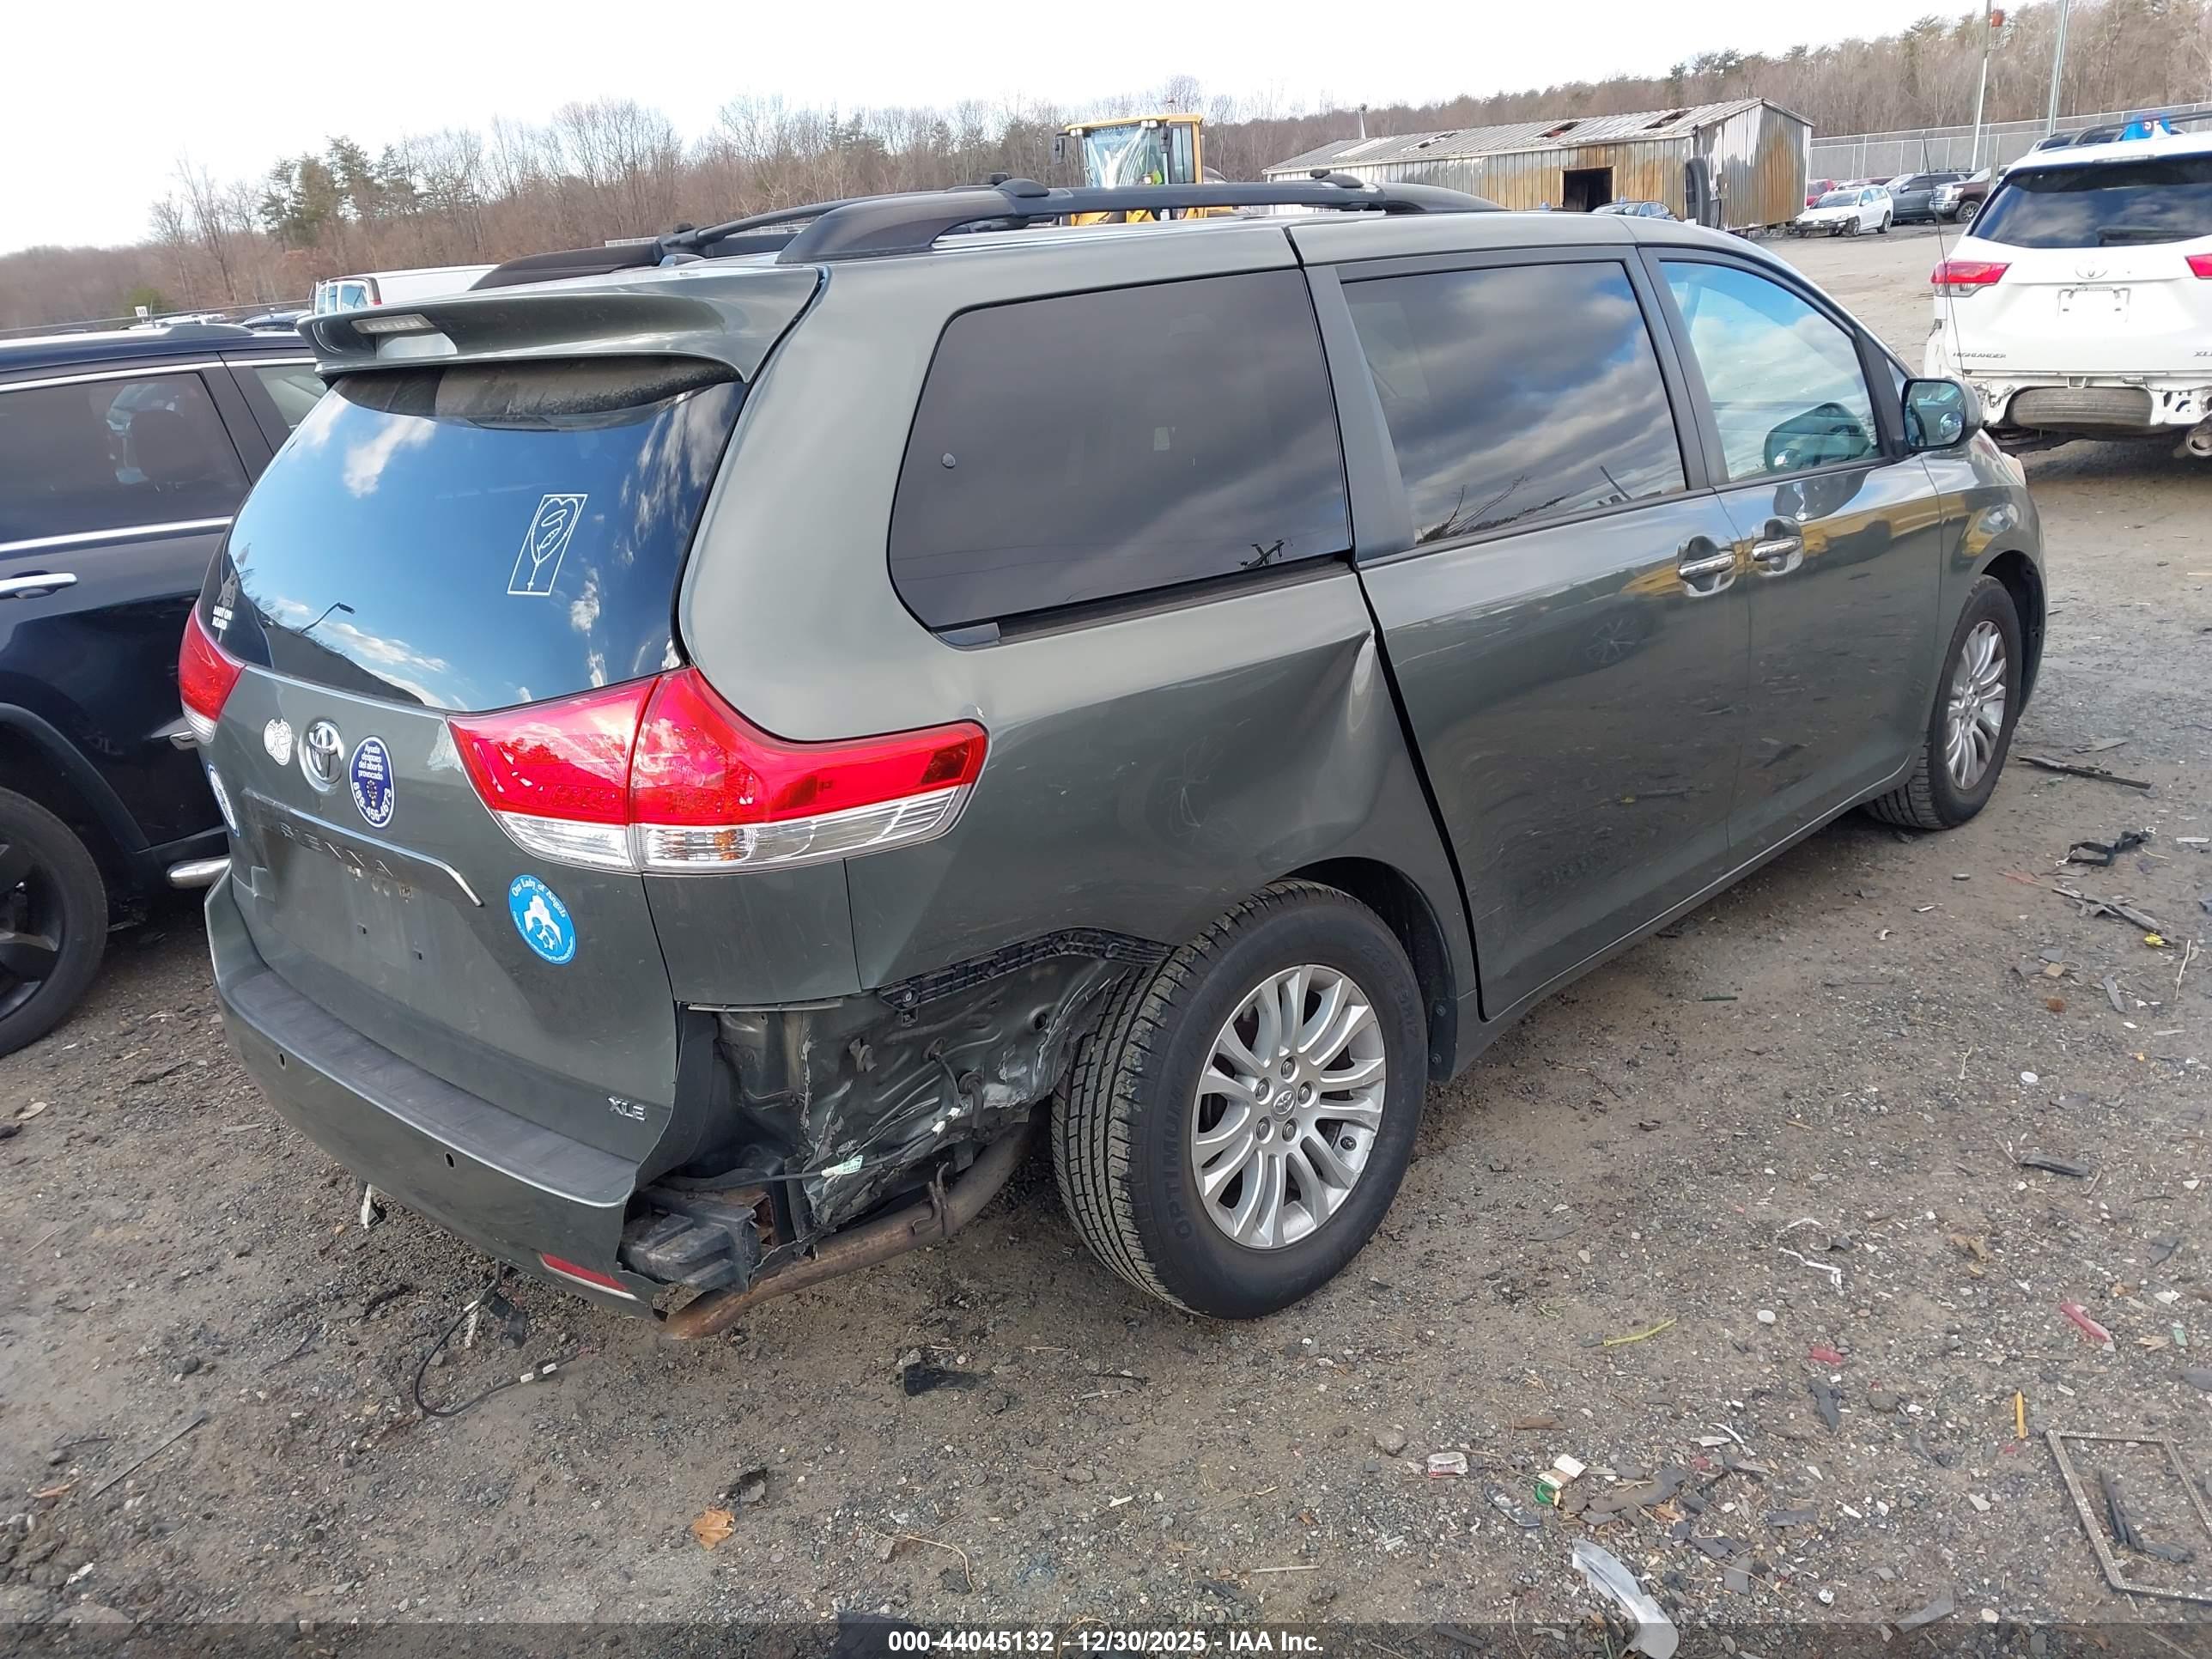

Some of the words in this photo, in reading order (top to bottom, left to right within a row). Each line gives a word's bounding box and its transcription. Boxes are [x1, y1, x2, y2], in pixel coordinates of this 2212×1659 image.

[511, 883, 522, 897] Our
[520, 878, 536, 890] Lady
[545, 891, 566, 918] Angels
[607, 1095, 647, 1121] XLE
